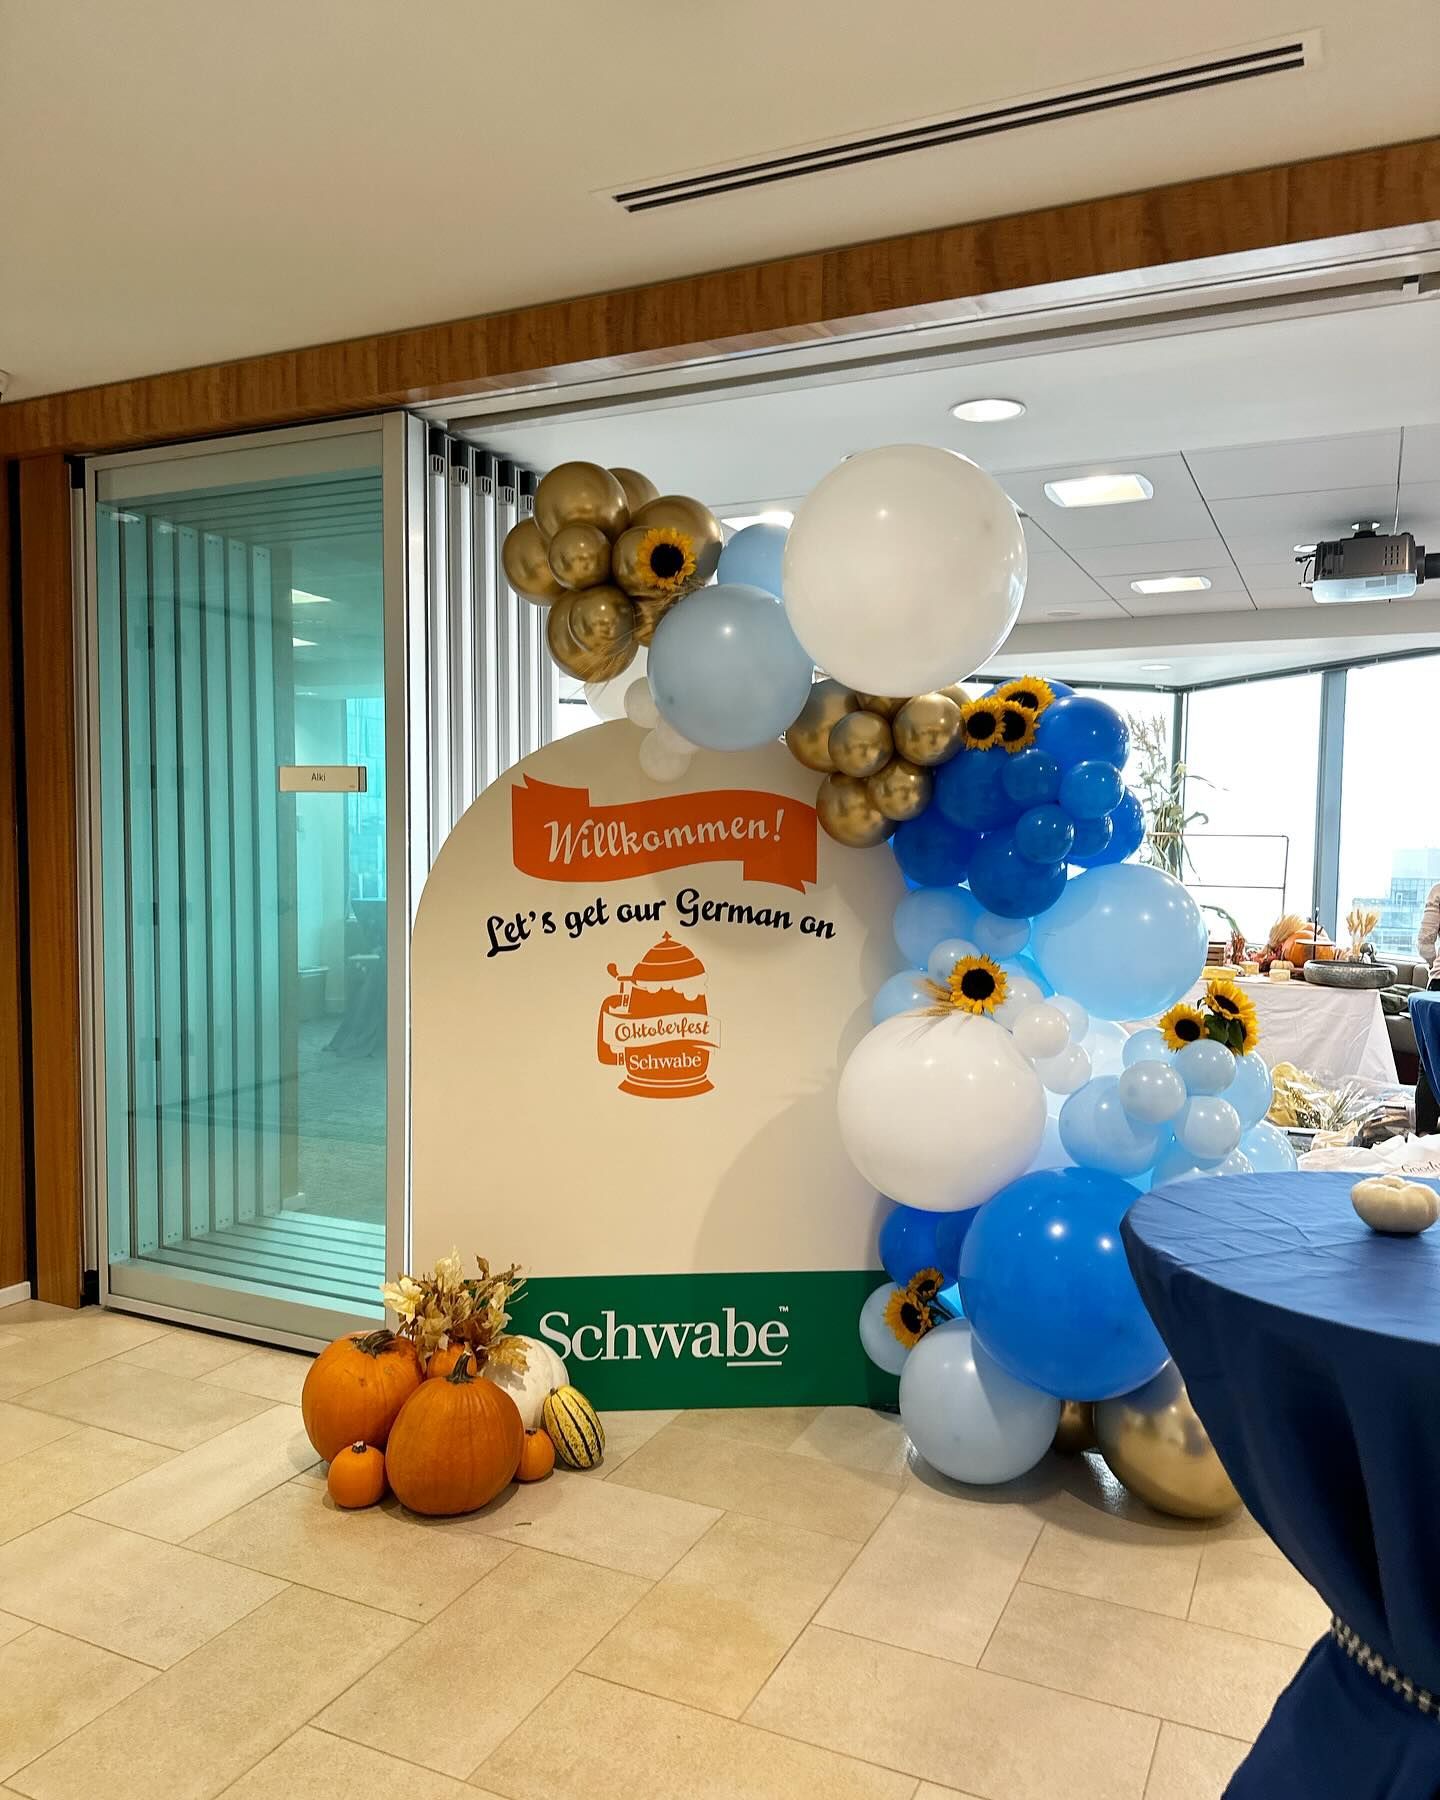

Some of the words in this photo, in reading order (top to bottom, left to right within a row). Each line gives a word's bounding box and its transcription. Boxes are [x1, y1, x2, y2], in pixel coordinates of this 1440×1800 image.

[311, 772, 326, 782] Alki
[543, 809, 784, 865] Willkommen!
[565, 897, 610, 938] get
[616, 900, 667, 923] our
[676, 888, 793, 929] German
[800, 916, 836, 939] on
[615, 1017, 709, 1041] Oktoberfest
[629, 1052, 702, 1071] Schwabe
[539, 1307, 789, 1361] Schwabe
